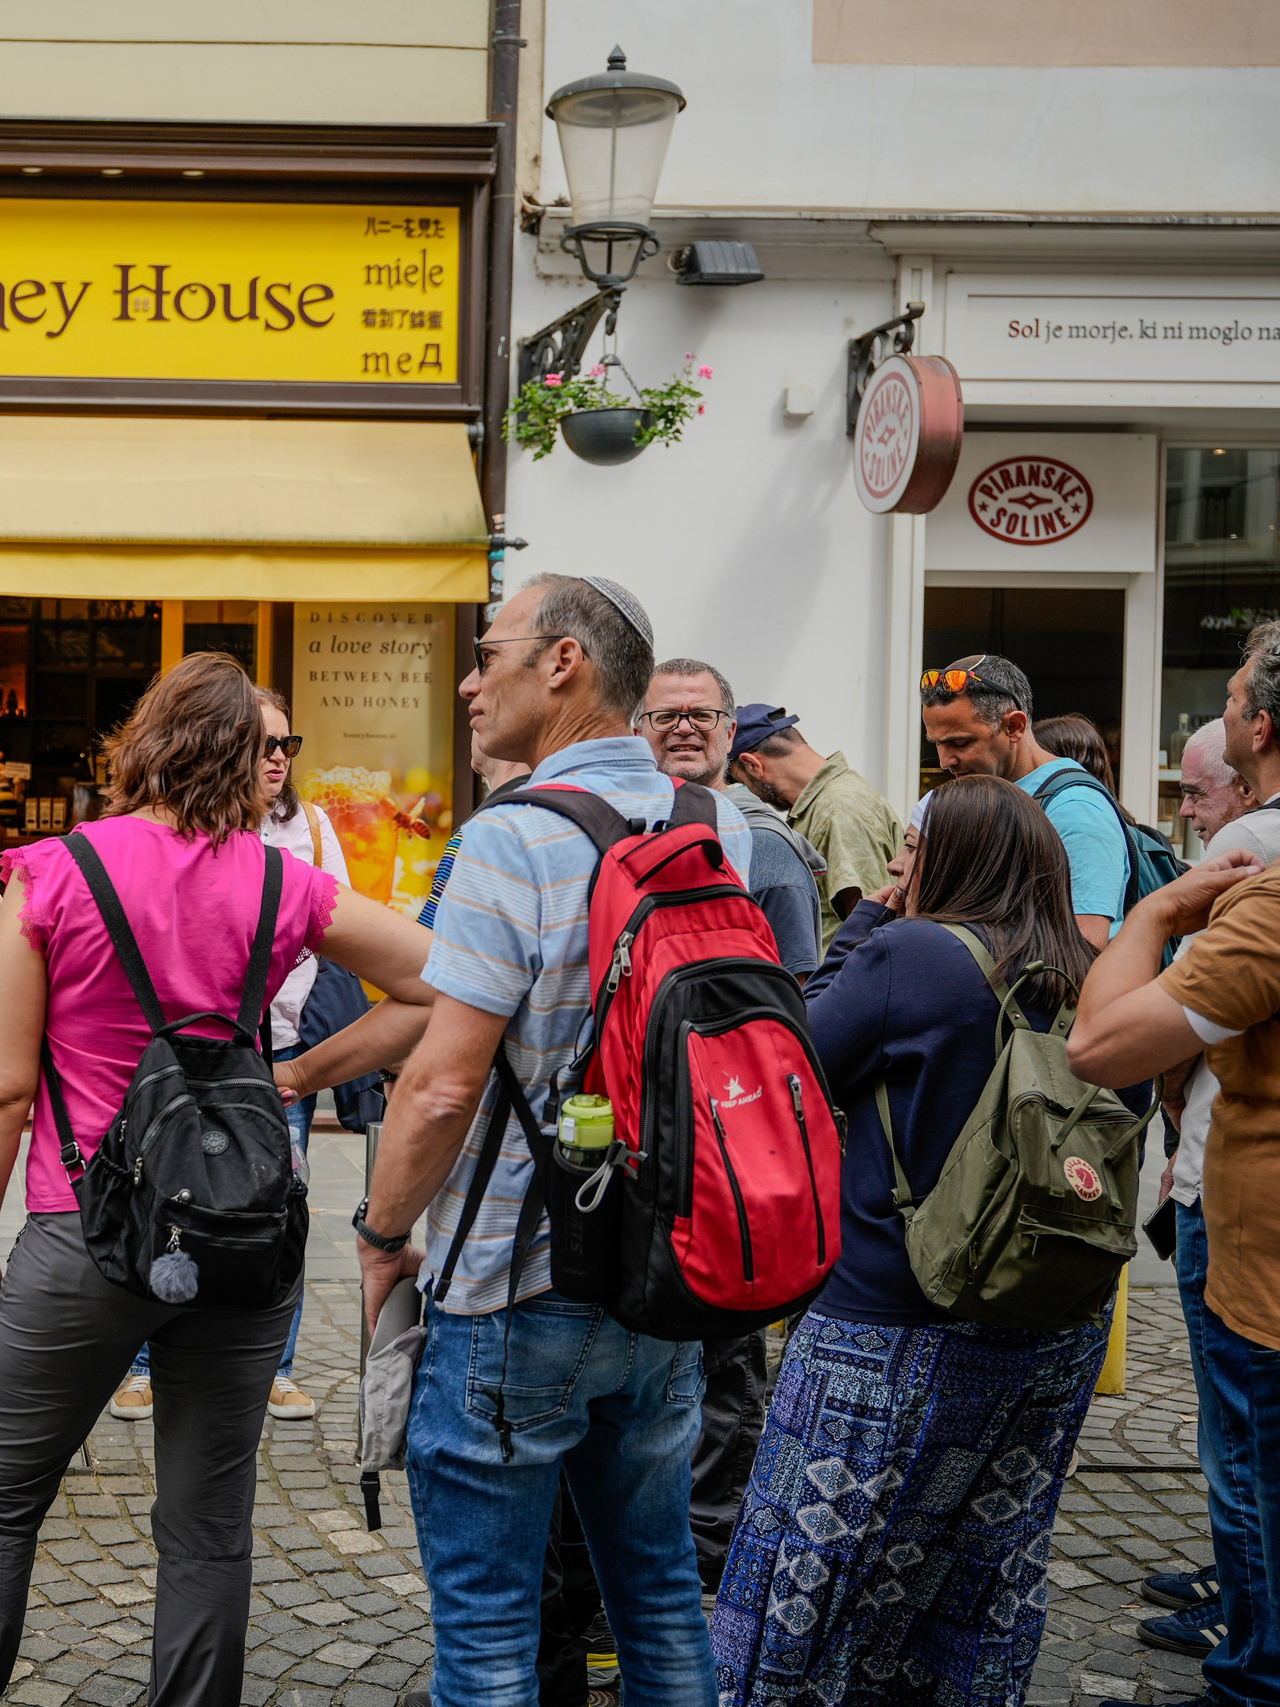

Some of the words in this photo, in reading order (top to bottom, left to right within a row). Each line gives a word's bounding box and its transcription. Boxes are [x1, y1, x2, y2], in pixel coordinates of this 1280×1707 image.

[364, 249, 444, 294] miele
[113, 263, 336, 331] House
[362, 309, 443, 330] 看到了蜂蜜
[1008, 318, 1040, 339] Sol
[1045, 321, 1063, 344] je
[1139, 319, 1157, 339] ki
[1163, 322, 1183, 340] ni
[1188, 320, 1253, 346] moglo
[865, 383, 909, 444] PIRANSKE
[868, 437, 904, 487] SOLINE
[979, 464, 1084, 503] PIRANSKE
[990, 507, 1072, 537] SOLINE
[310, 611, 434, 624] DISCOVER
[309, 639, 322, 654] a
[331, 635, 372, 654] love
[380, 639, 433, 659] story
[309, 670, 393, 682] BETWEEN
[401, 672, 433, 684] BEE
[320, 696, 354, 708] AND
[363, 696, 420, 708] HONEY
